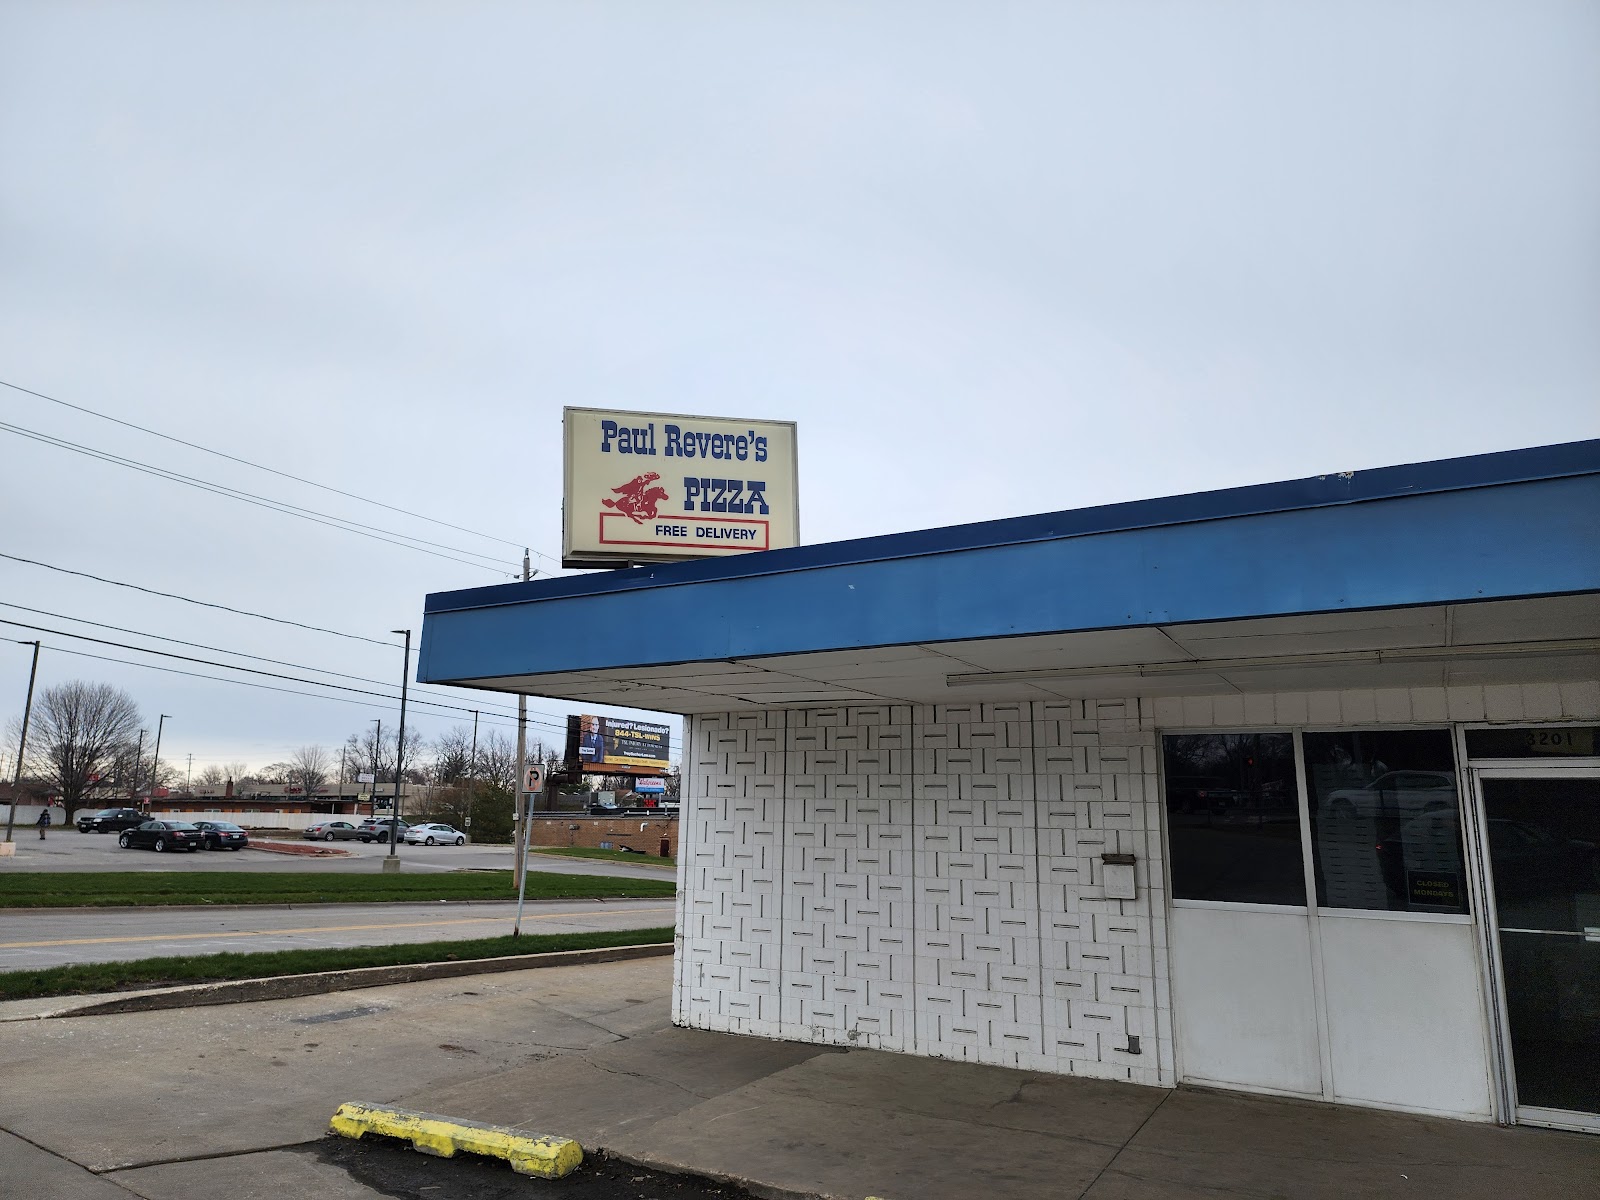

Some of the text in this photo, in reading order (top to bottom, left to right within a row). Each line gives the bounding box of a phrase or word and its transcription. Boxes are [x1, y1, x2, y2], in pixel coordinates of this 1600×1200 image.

[601, 420, 768, 462] Paul Revere's
[684, 477, 769, 515] PIZZA
[655, 525, 757, 540] FREE DELIVERY
[605, 720, 669, 735] Injured? Lesionado?
[615, 729, 661, 741] 844-TSL-WINS
[1527, 732, 1572, 746] 3201
[1416, 880, 1449, 888] CLOSED
[1413, 889, 1454, 898] MONDAYS
